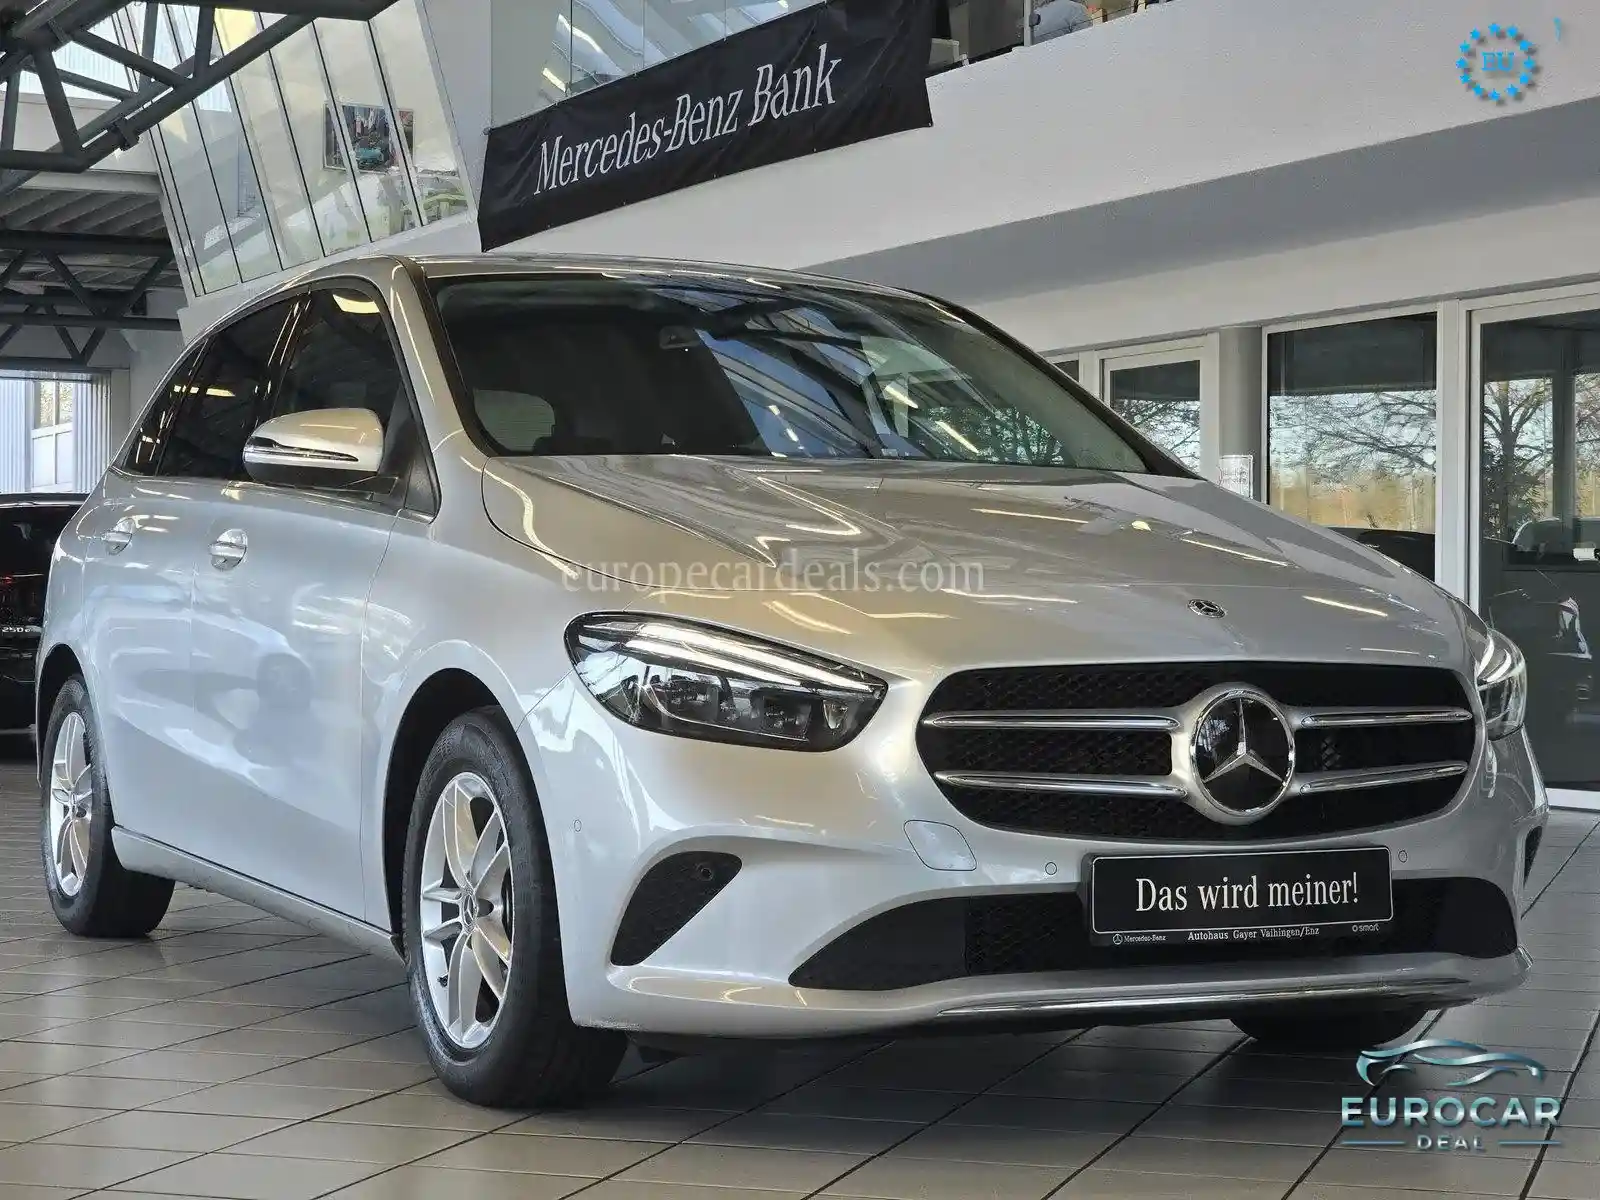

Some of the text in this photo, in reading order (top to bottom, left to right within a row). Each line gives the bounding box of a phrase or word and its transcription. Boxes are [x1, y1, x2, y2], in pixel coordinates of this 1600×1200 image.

[533, 43, 842, 195] Mercedes-Benz Bank
[1136, 871, 1359, 912] Das wird meiner!
[1187, 926, 1320, 941] Autohaus Gayer Vaihingen/Enz
[1358, 923, 1380, 932] smart
[1124, 934, 1167, 943] Mercedes-Benz
